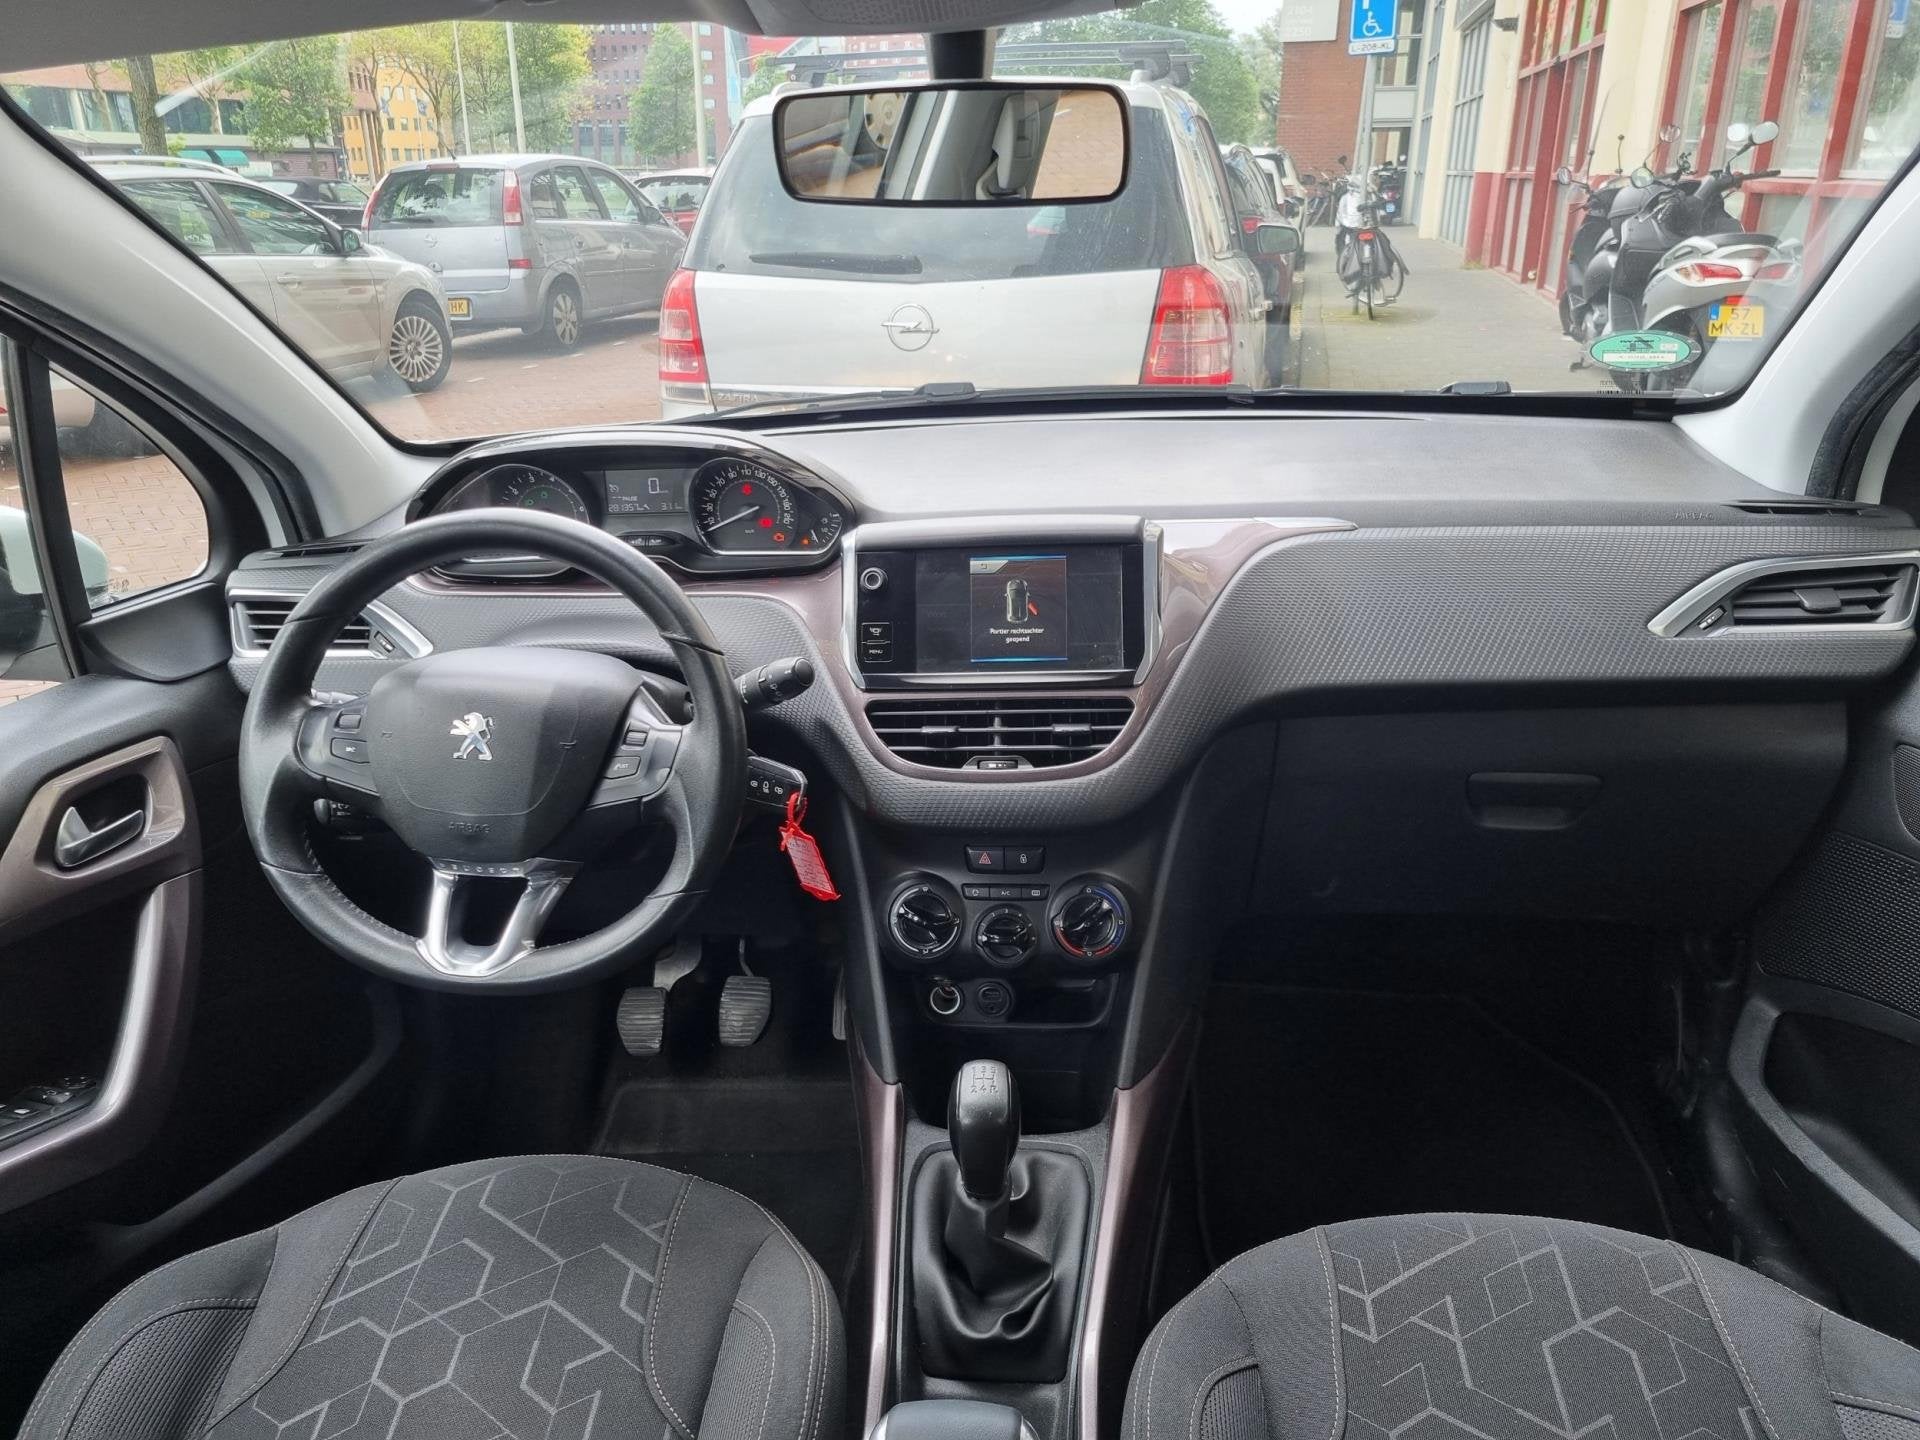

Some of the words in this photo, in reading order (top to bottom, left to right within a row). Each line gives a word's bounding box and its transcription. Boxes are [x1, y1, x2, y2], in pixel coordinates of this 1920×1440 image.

[1731, 308, 1750, 320] 57
[1711, 323, 1759, 335] MK-ZL
[648, 477, 660, 494] 0
[448, 821, 490, 833] AIRBAG
